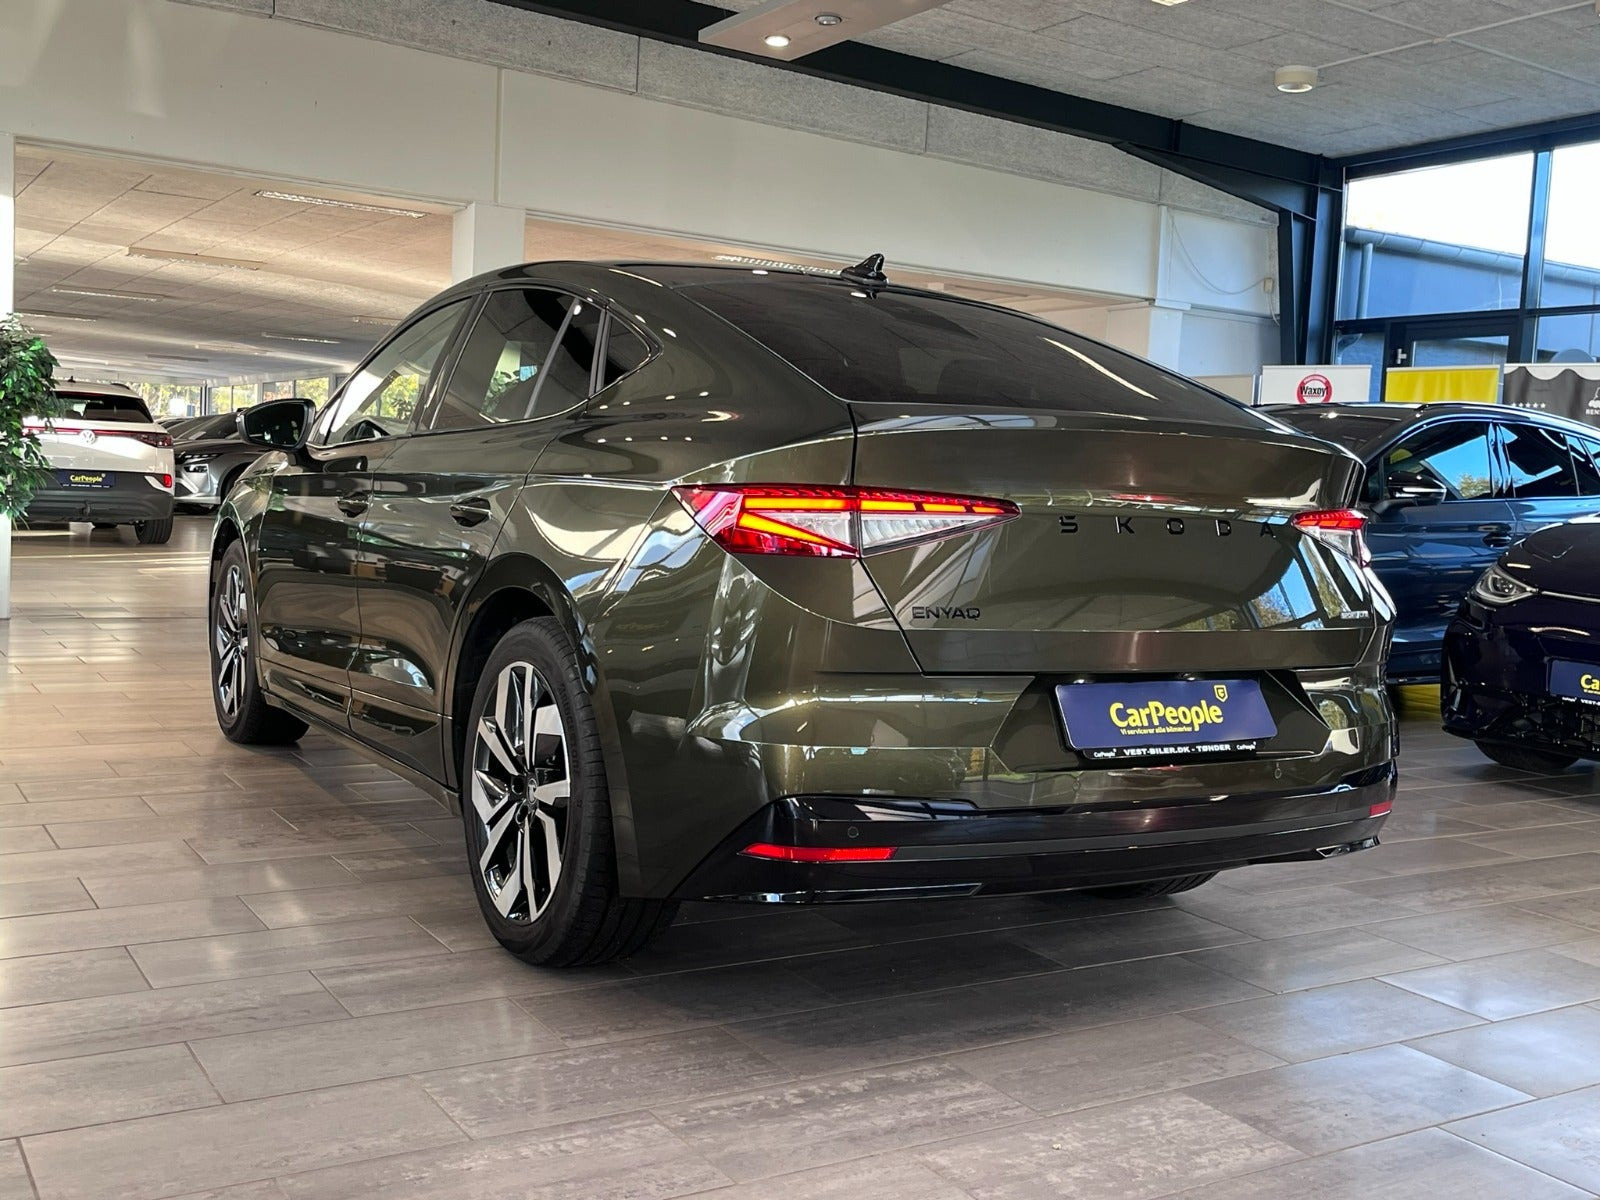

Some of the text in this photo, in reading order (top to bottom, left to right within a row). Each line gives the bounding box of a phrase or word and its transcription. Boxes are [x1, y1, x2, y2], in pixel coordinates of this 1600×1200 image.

[70, 474, 103, 484] CarPeople
[912, 606, 981, 621] ENYAQ
[1109, 699, 1224, 732] CarPeople
[1123, 746, 1190, 756] VEST-BILER.DK
